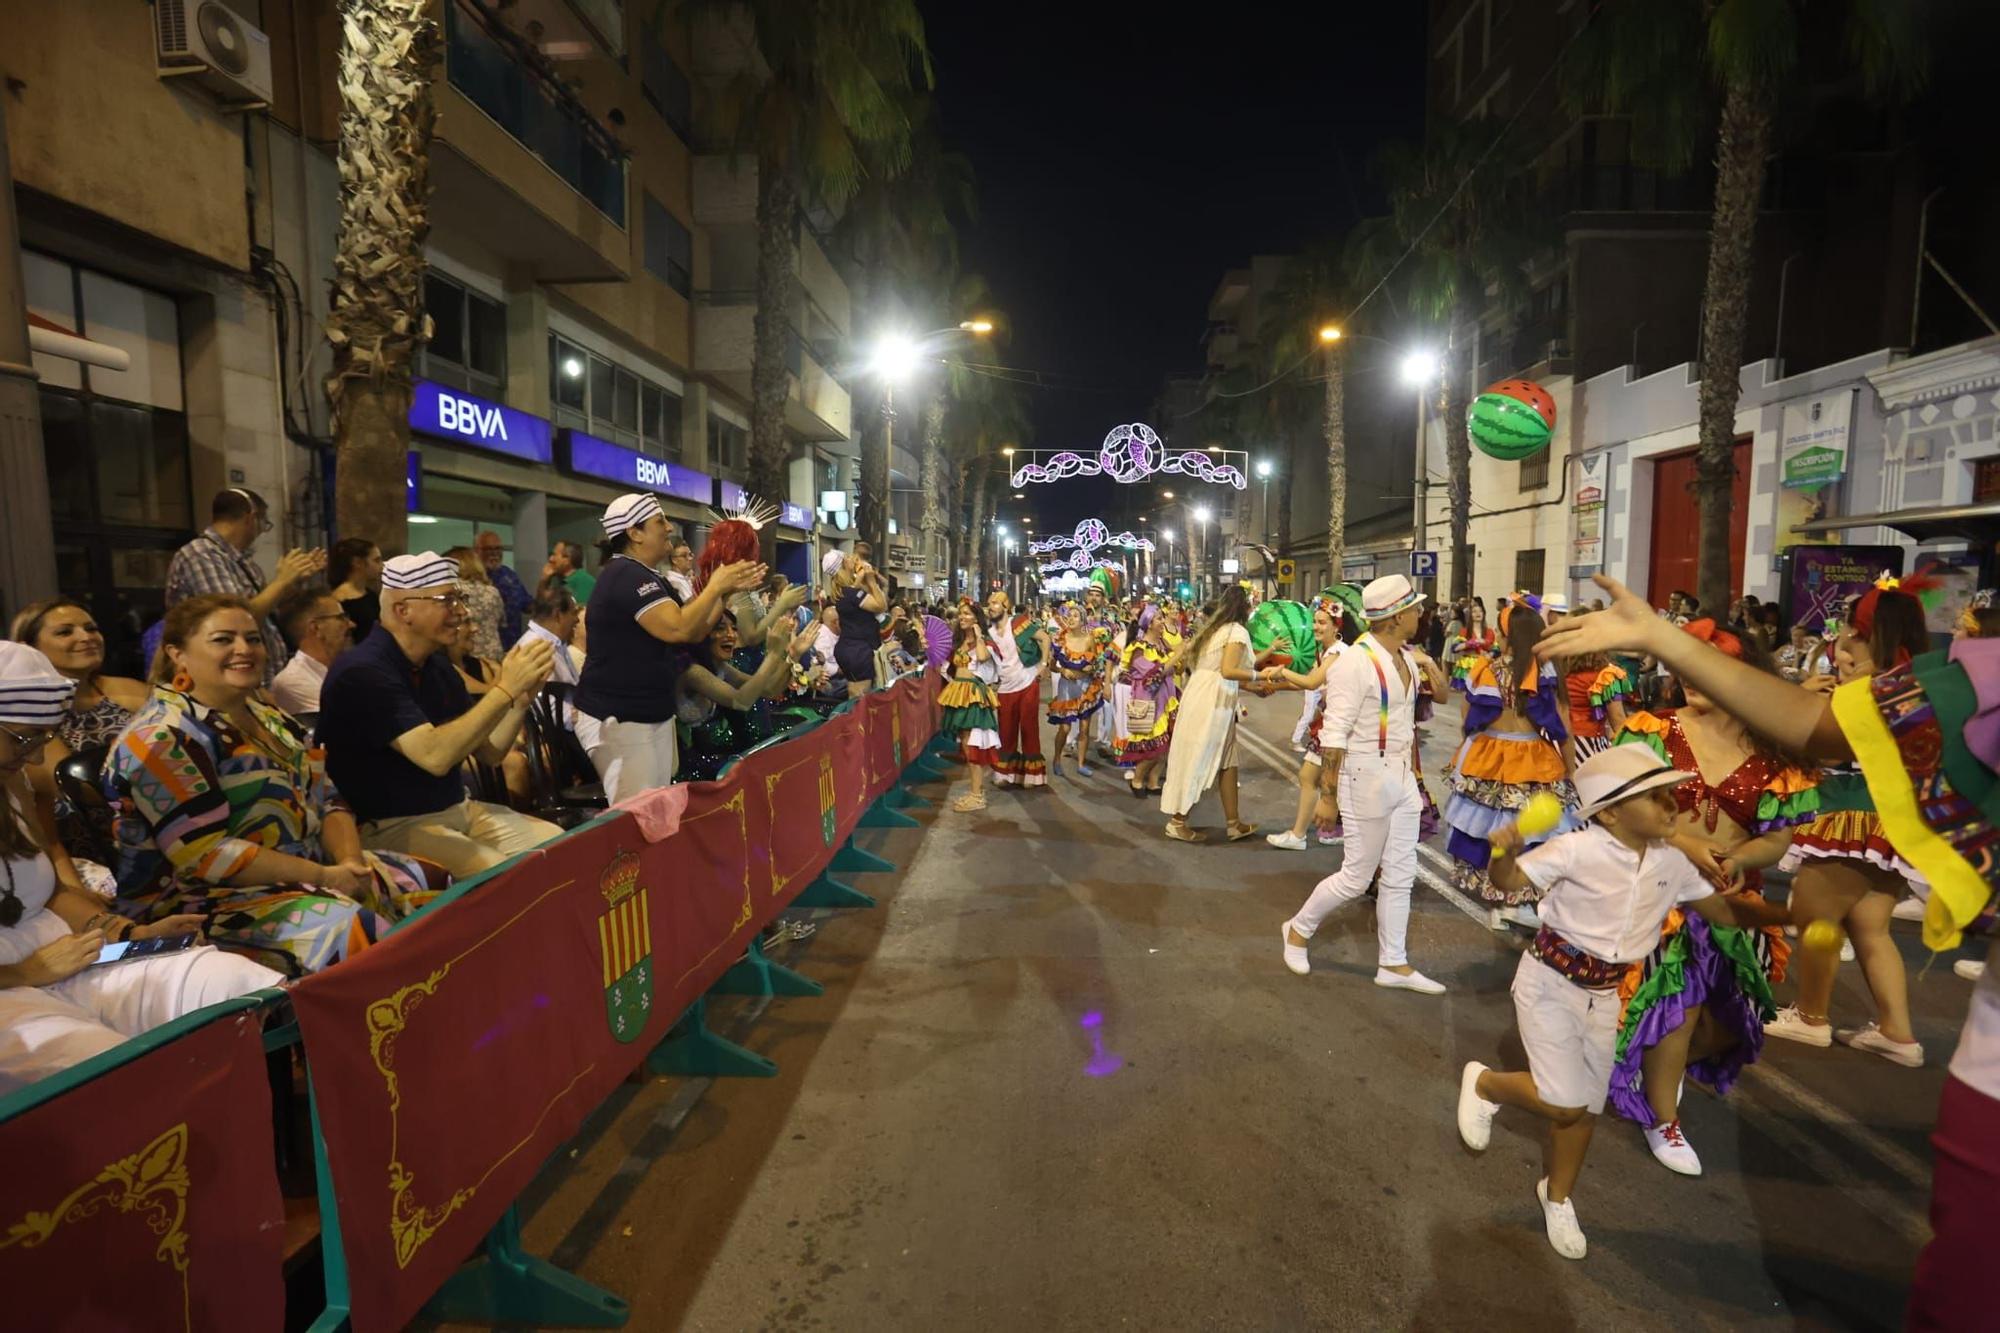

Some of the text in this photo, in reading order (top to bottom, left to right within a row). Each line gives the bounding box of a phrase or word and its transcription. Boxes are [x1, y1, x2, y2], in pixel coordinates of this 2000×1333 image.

[438, 392, 508, 441] BBVA
[636, 457, 671, 487] BBVA
[1416, 554, 1432, 574] P
[1840, 557, 1854, 565] YA
[1824, 565, 1868, 574] ESTAMOS
[1824, 574, 1866, 583] CONTIGO
